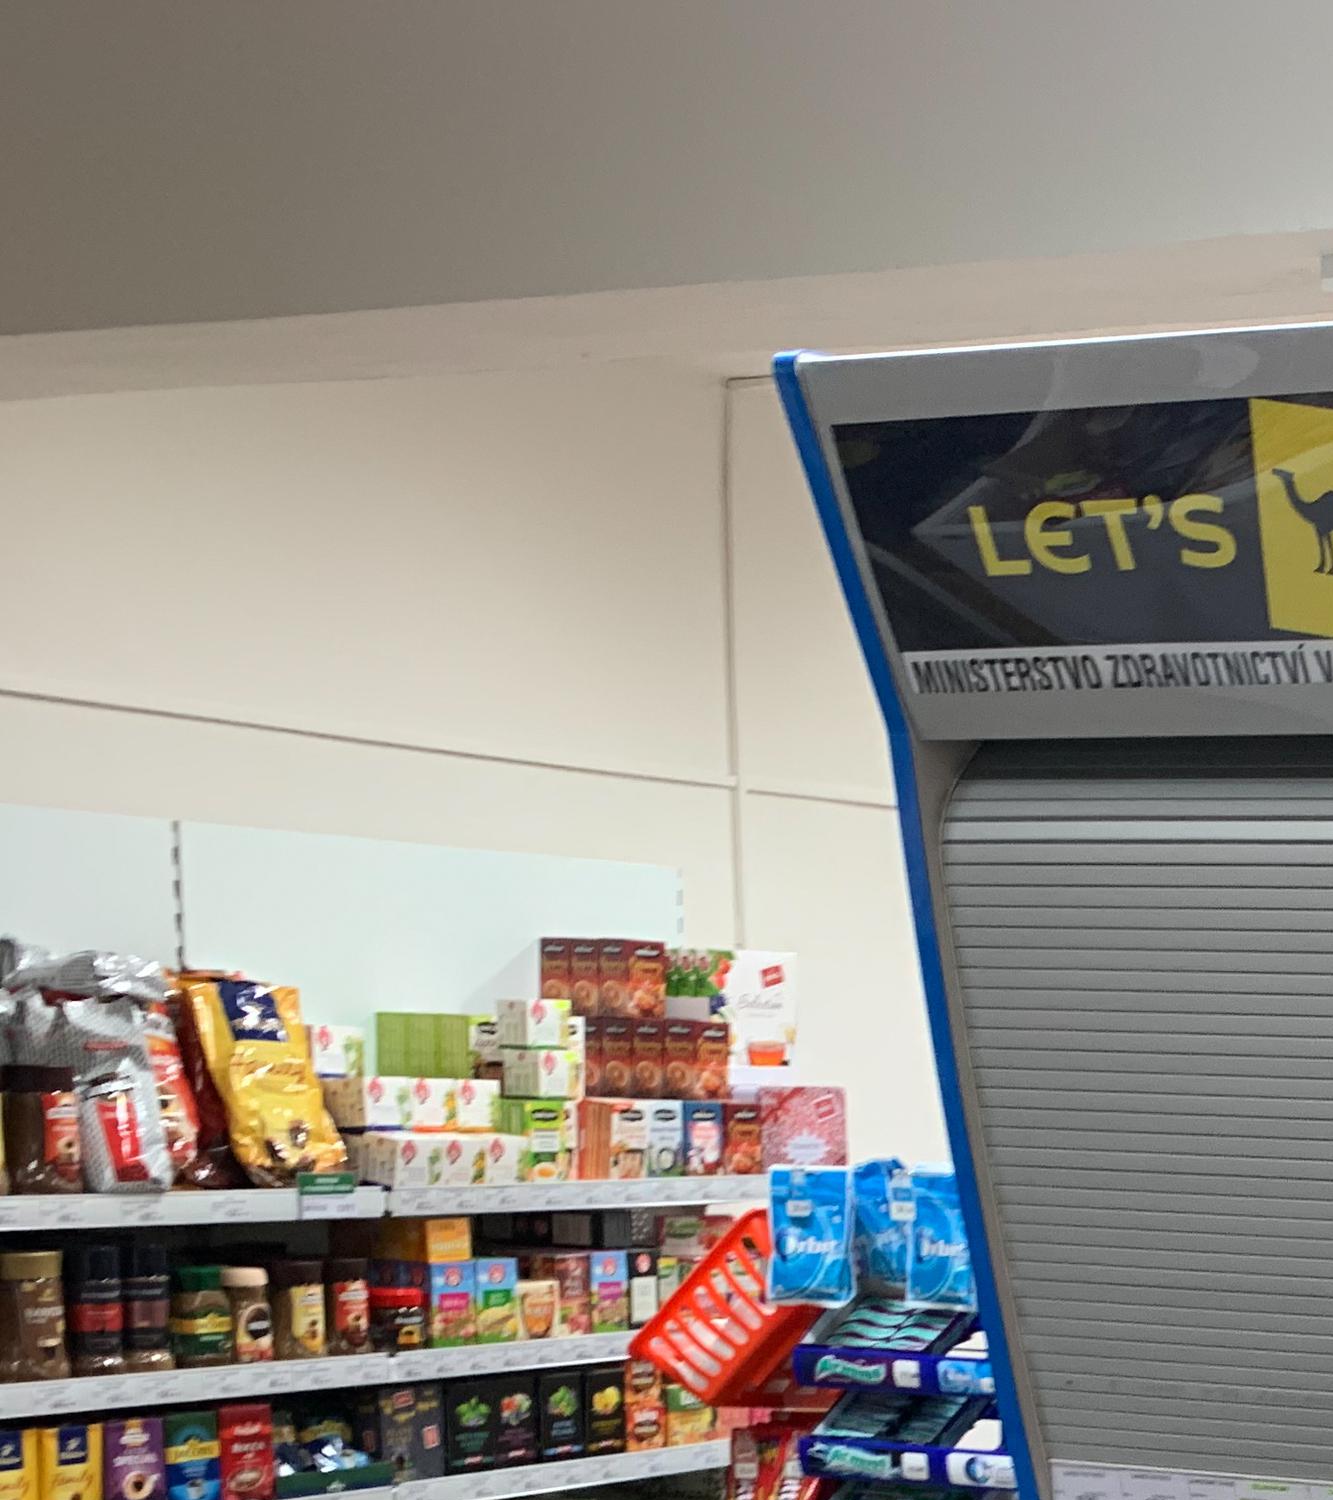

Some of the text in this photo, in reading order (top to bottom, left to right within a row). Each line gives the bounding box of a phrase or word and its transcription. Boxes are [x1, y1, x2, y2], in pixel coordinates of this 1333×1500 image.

[967, 493, 1237, 577] LET'S
[911, 653, 1102, 694] MINISTERSTVO
[1103, 643, 1309, 689] ZDRAVOTNICTVÍ
